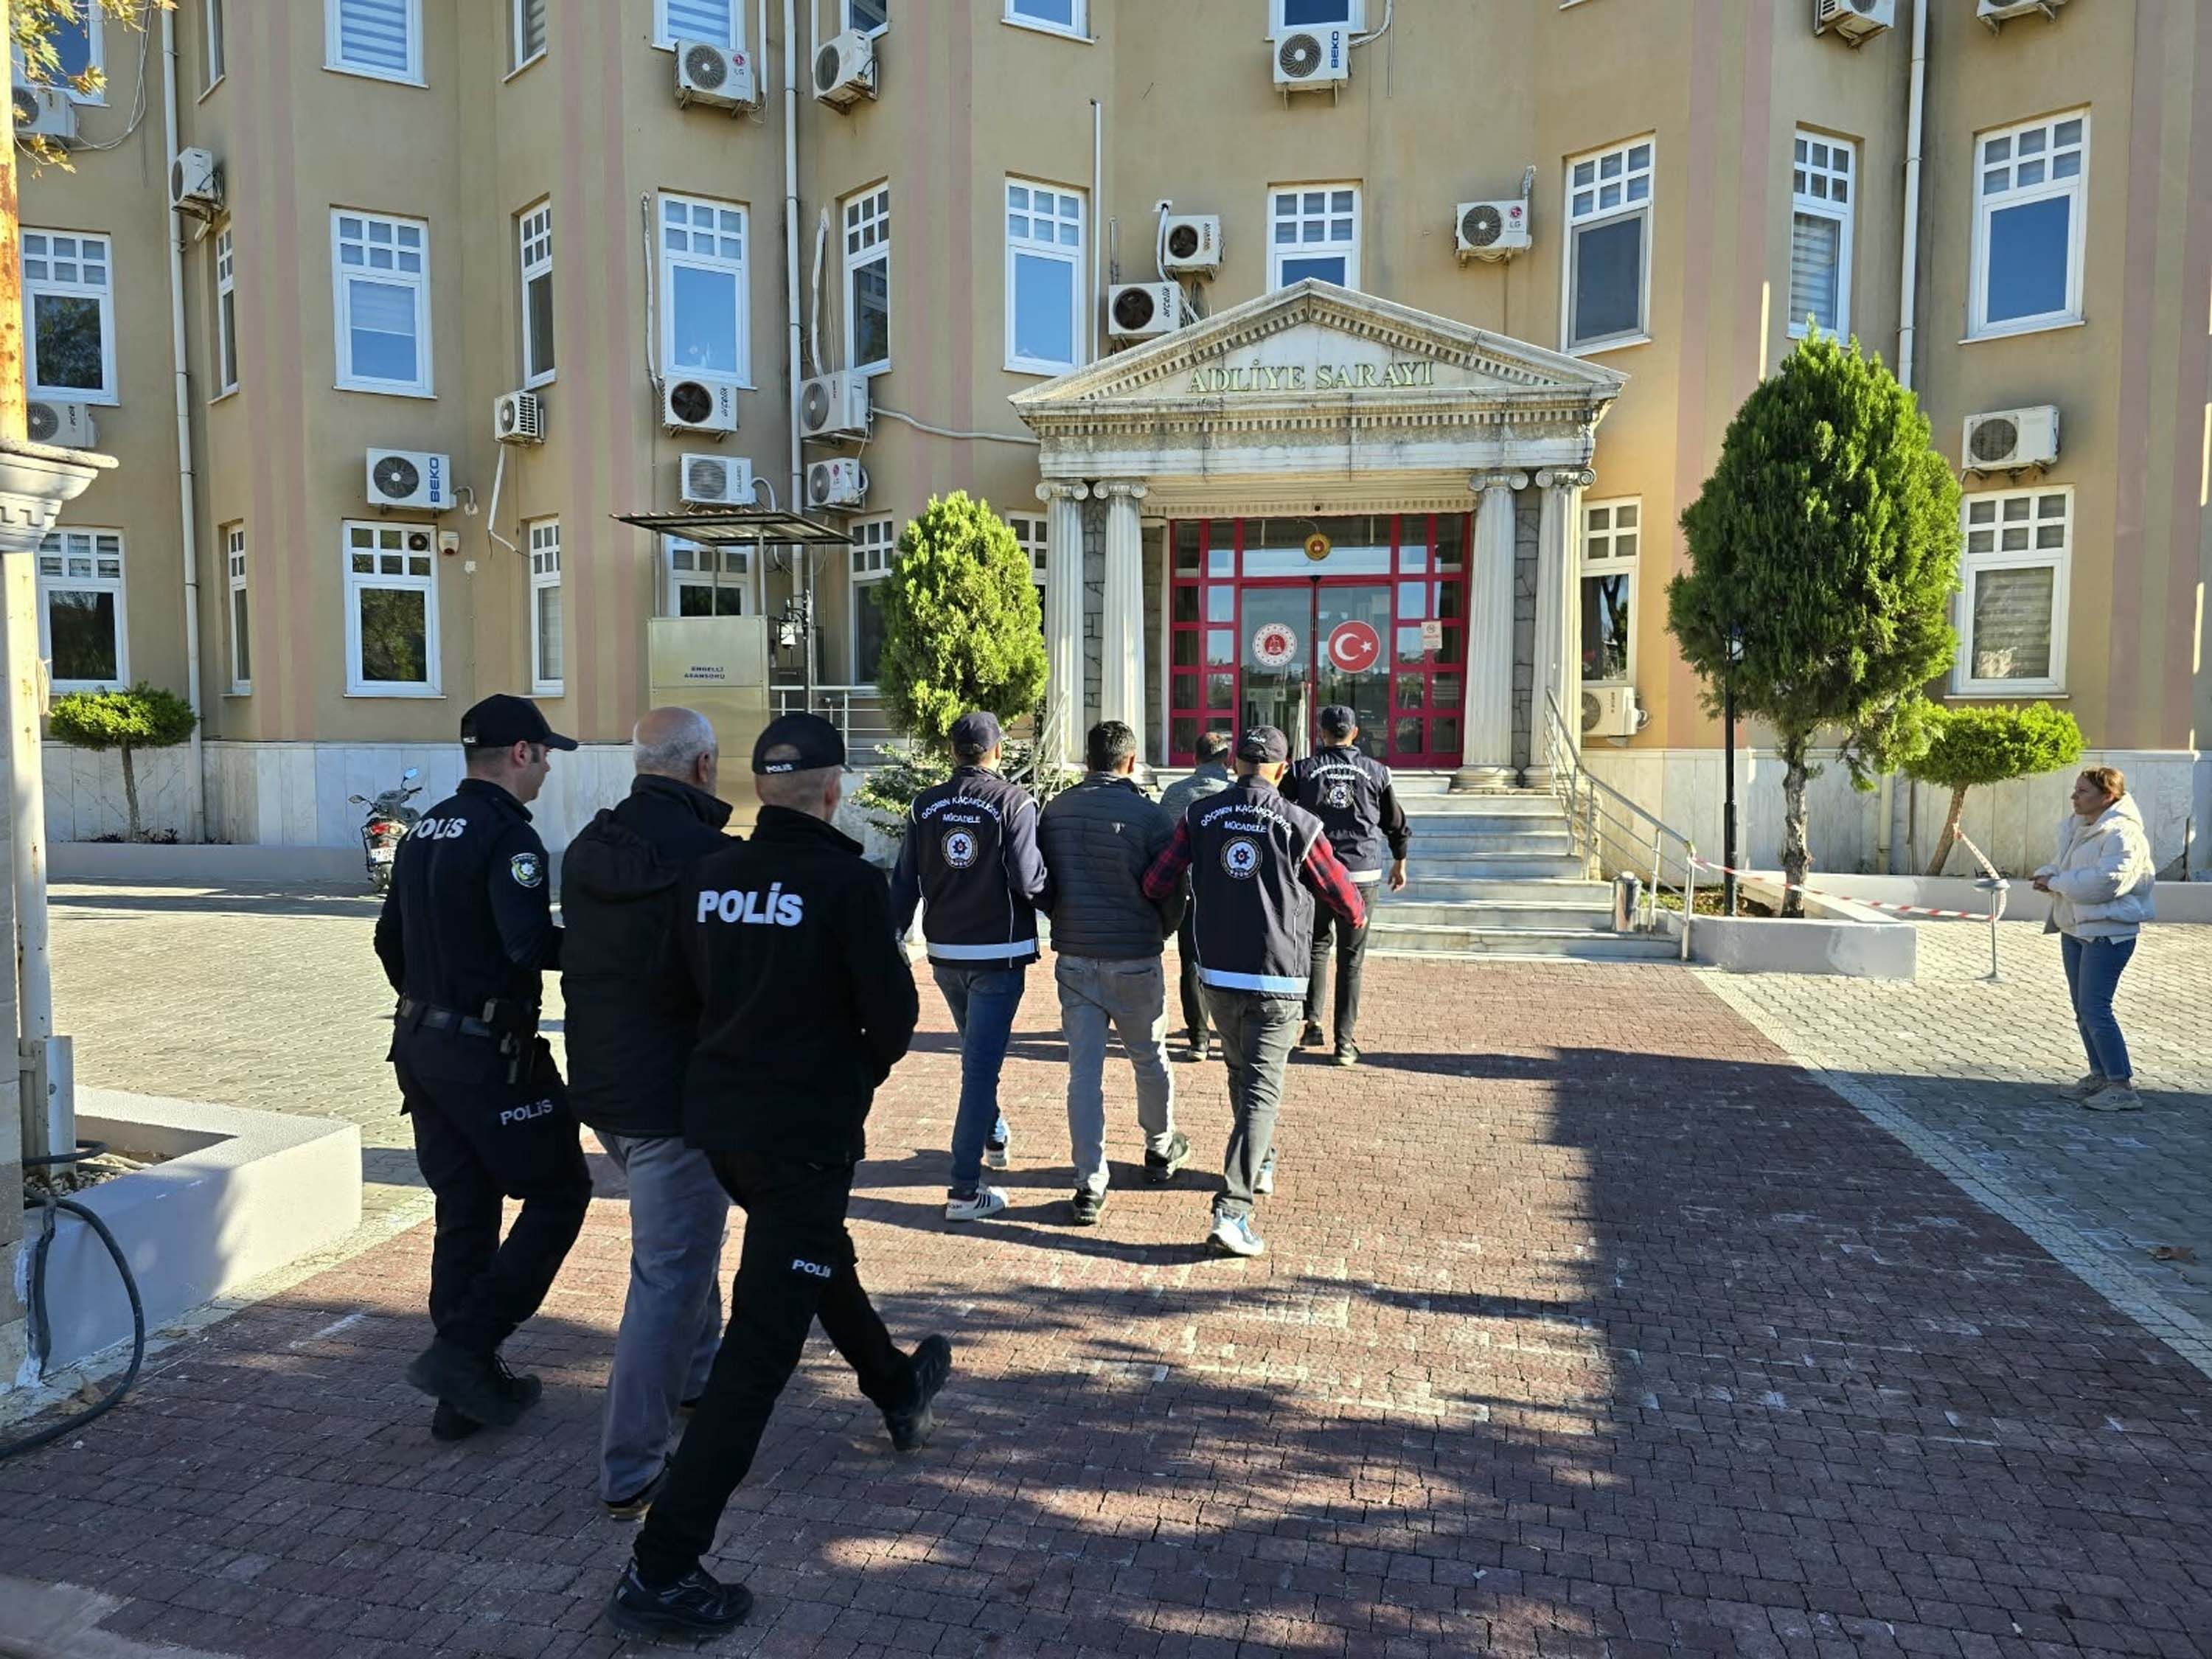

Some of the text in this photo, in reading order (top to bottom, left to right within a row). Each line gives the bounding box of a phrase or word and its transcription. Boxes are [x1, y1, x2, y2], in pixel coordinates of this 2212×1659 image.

[1331, 31, 1339, 69] BEKO
[1186, 359, 1435, 393] ADLİYE SARAYI
[429, 457, 440, 502] BEKO
[697, 882, 804, 927] POLİS
[500, 1099, 553, 1126] POLİS
